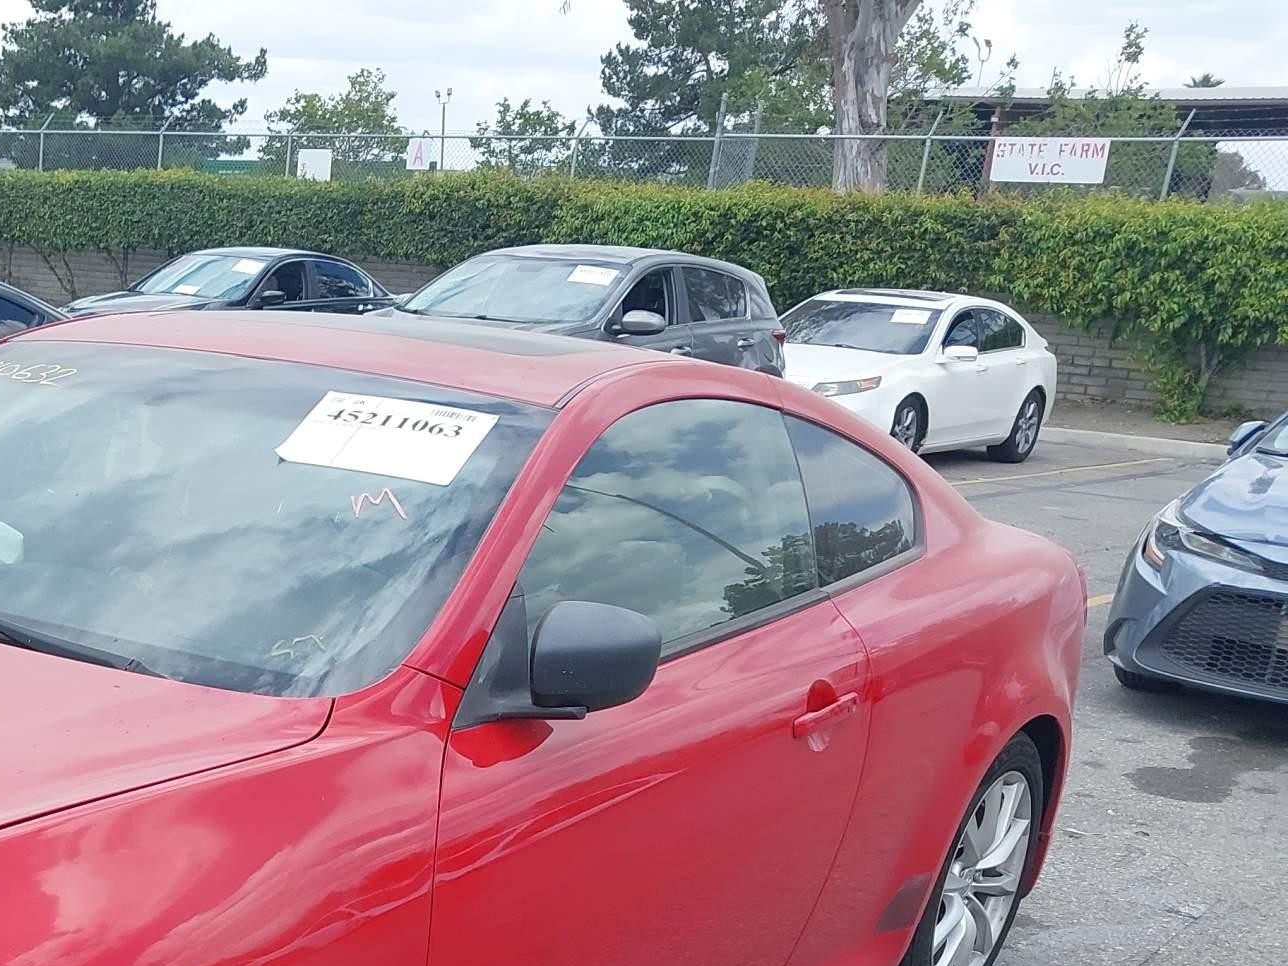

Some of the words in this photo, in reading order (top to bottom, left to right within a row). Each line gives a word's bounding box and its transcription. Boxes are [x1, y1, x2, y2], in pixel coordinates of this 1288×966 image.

[412, 141, 423, 166] A
[996, 143, 1048, 158] STATE
[1058, 143, 1106, 158] FARM
[1028, 163, 1065, 176] V.I.C.
[327, 408, 463, 438] 45211063
